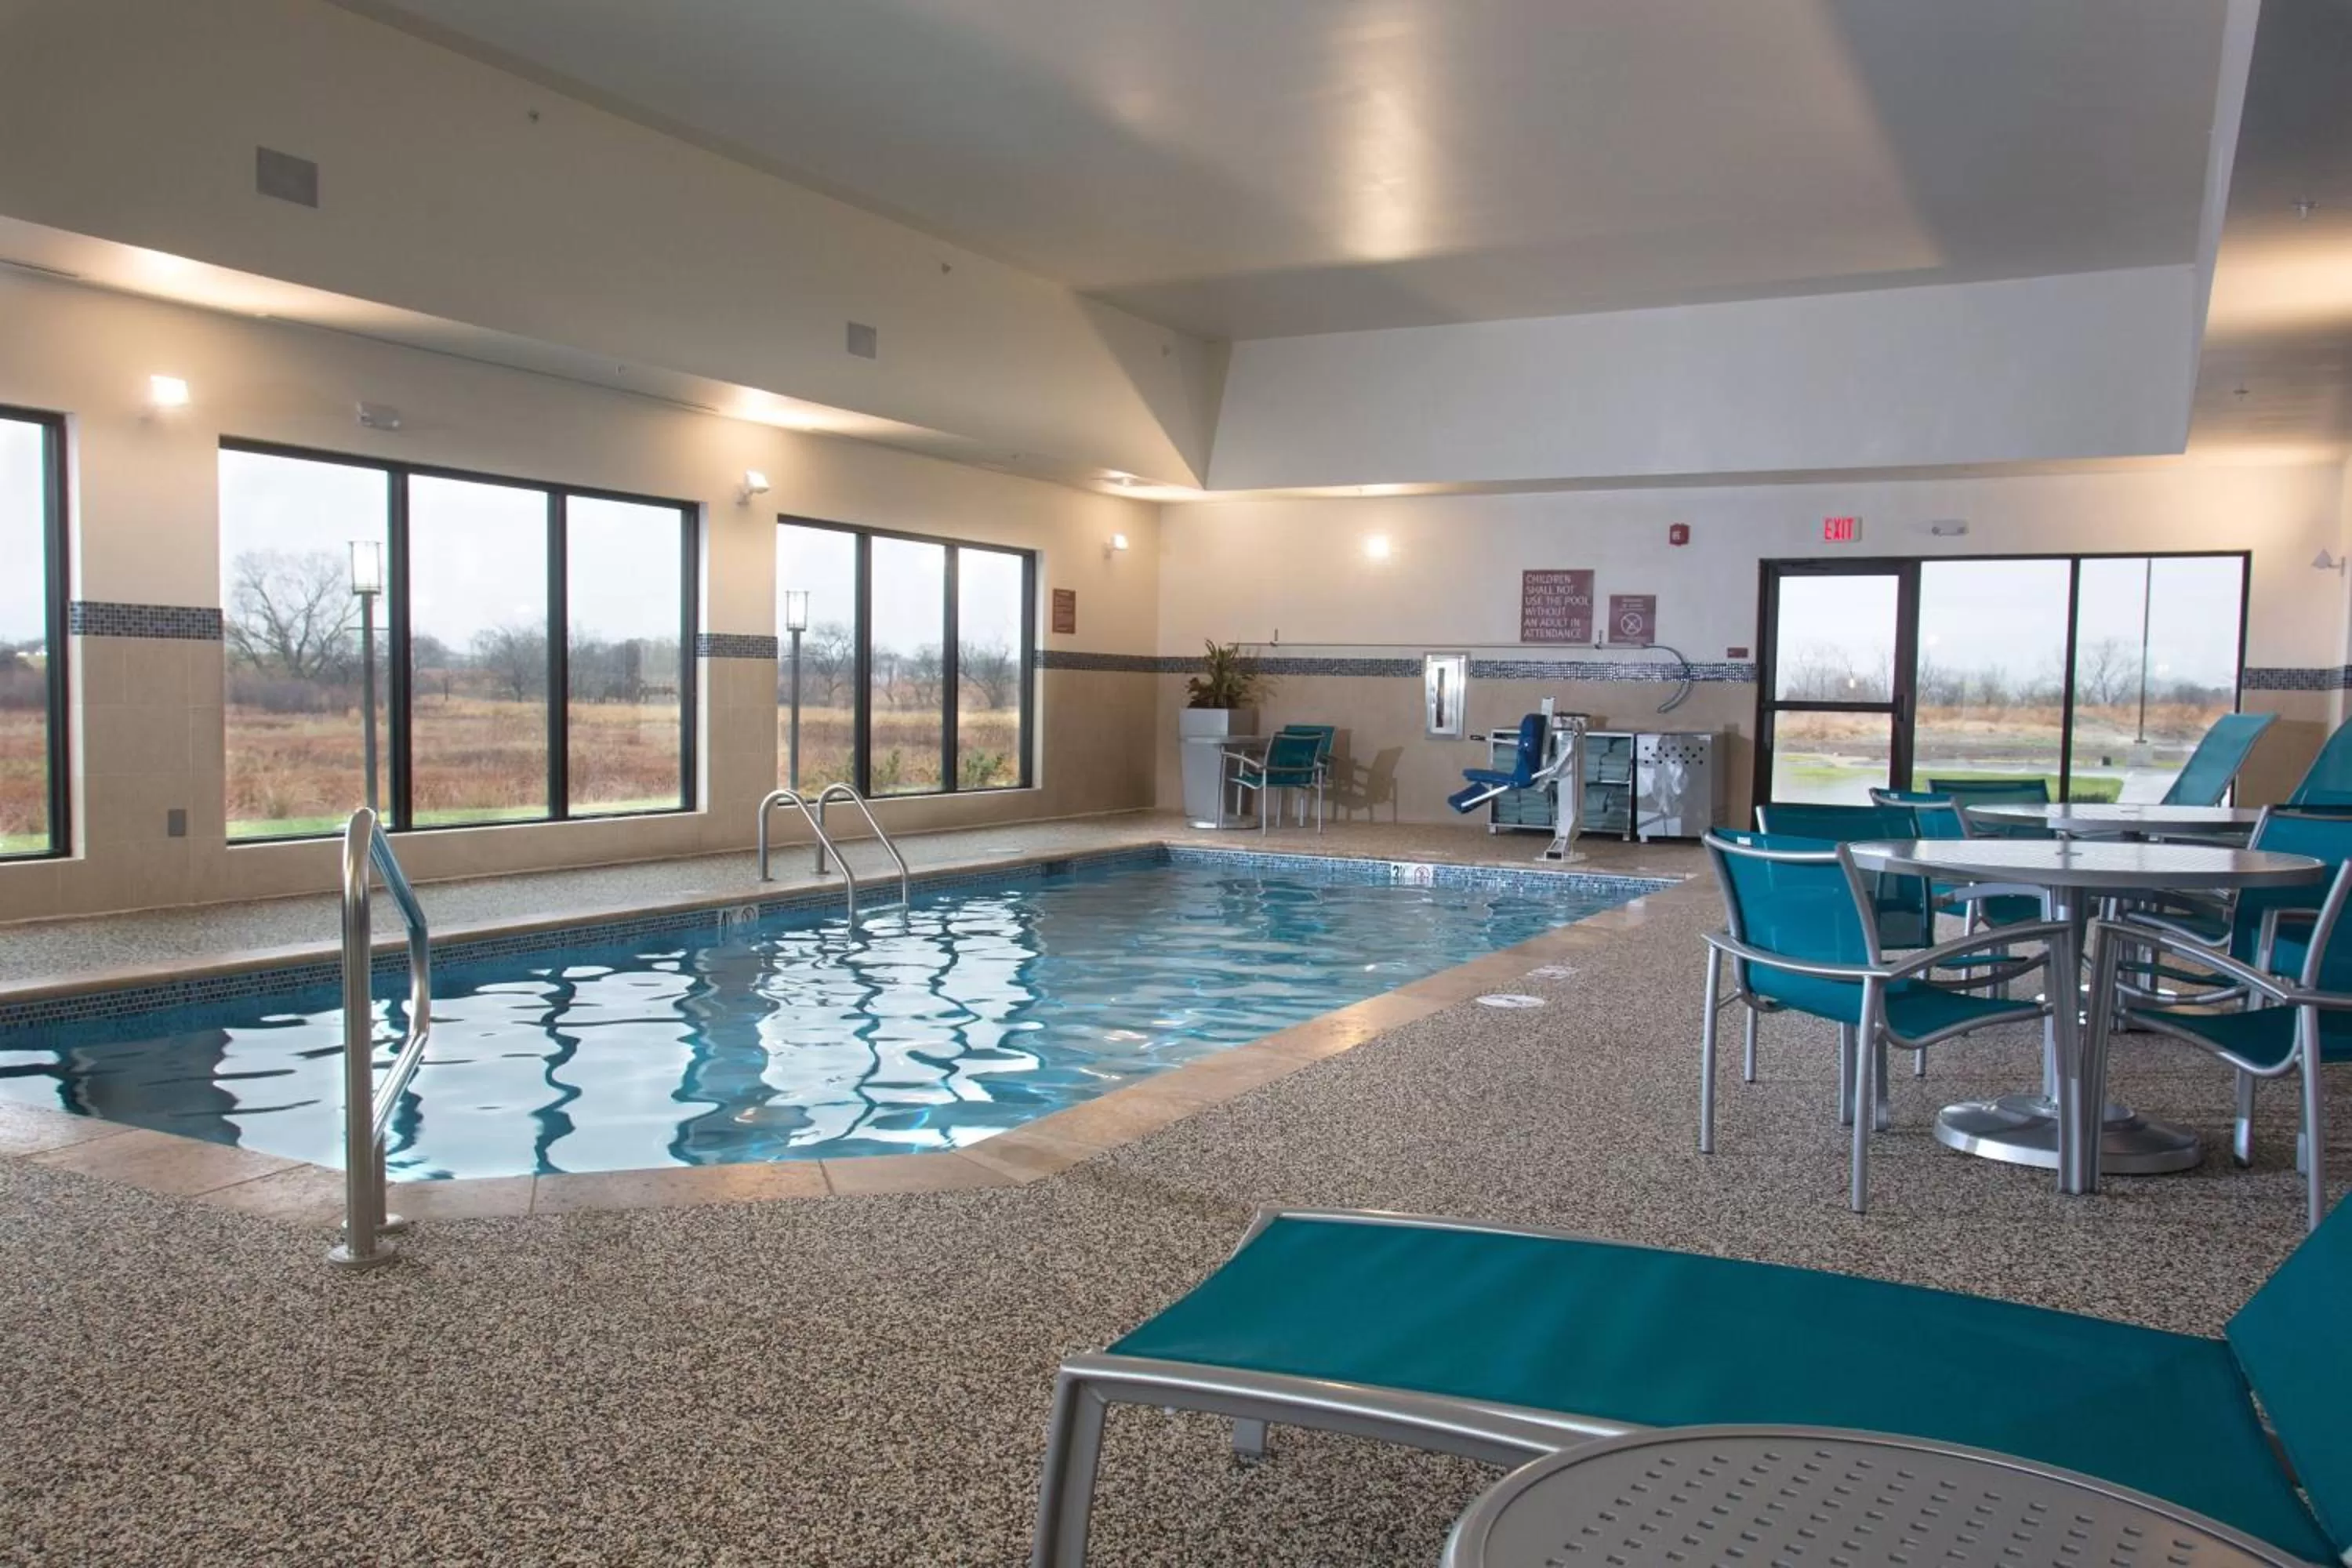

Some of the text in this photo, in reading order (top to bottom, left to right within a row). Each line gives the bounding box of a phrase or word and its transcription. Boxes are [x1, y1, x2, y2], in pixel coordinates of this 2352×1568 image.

[1824, 517, 1854, 539] EXIT
[1525, 574, 1571, 584] CHILDREN
[1525, 585, 1575, 594] SHALL NOT
[1525, 596, 1588, 606] USE THE POOL
[1525, 607, 1566, 615] WITHOUT
[1523, 618, 1581, 627] AN ADULT IN
[1523, 629, 1581, 639] ATTENDANCE
